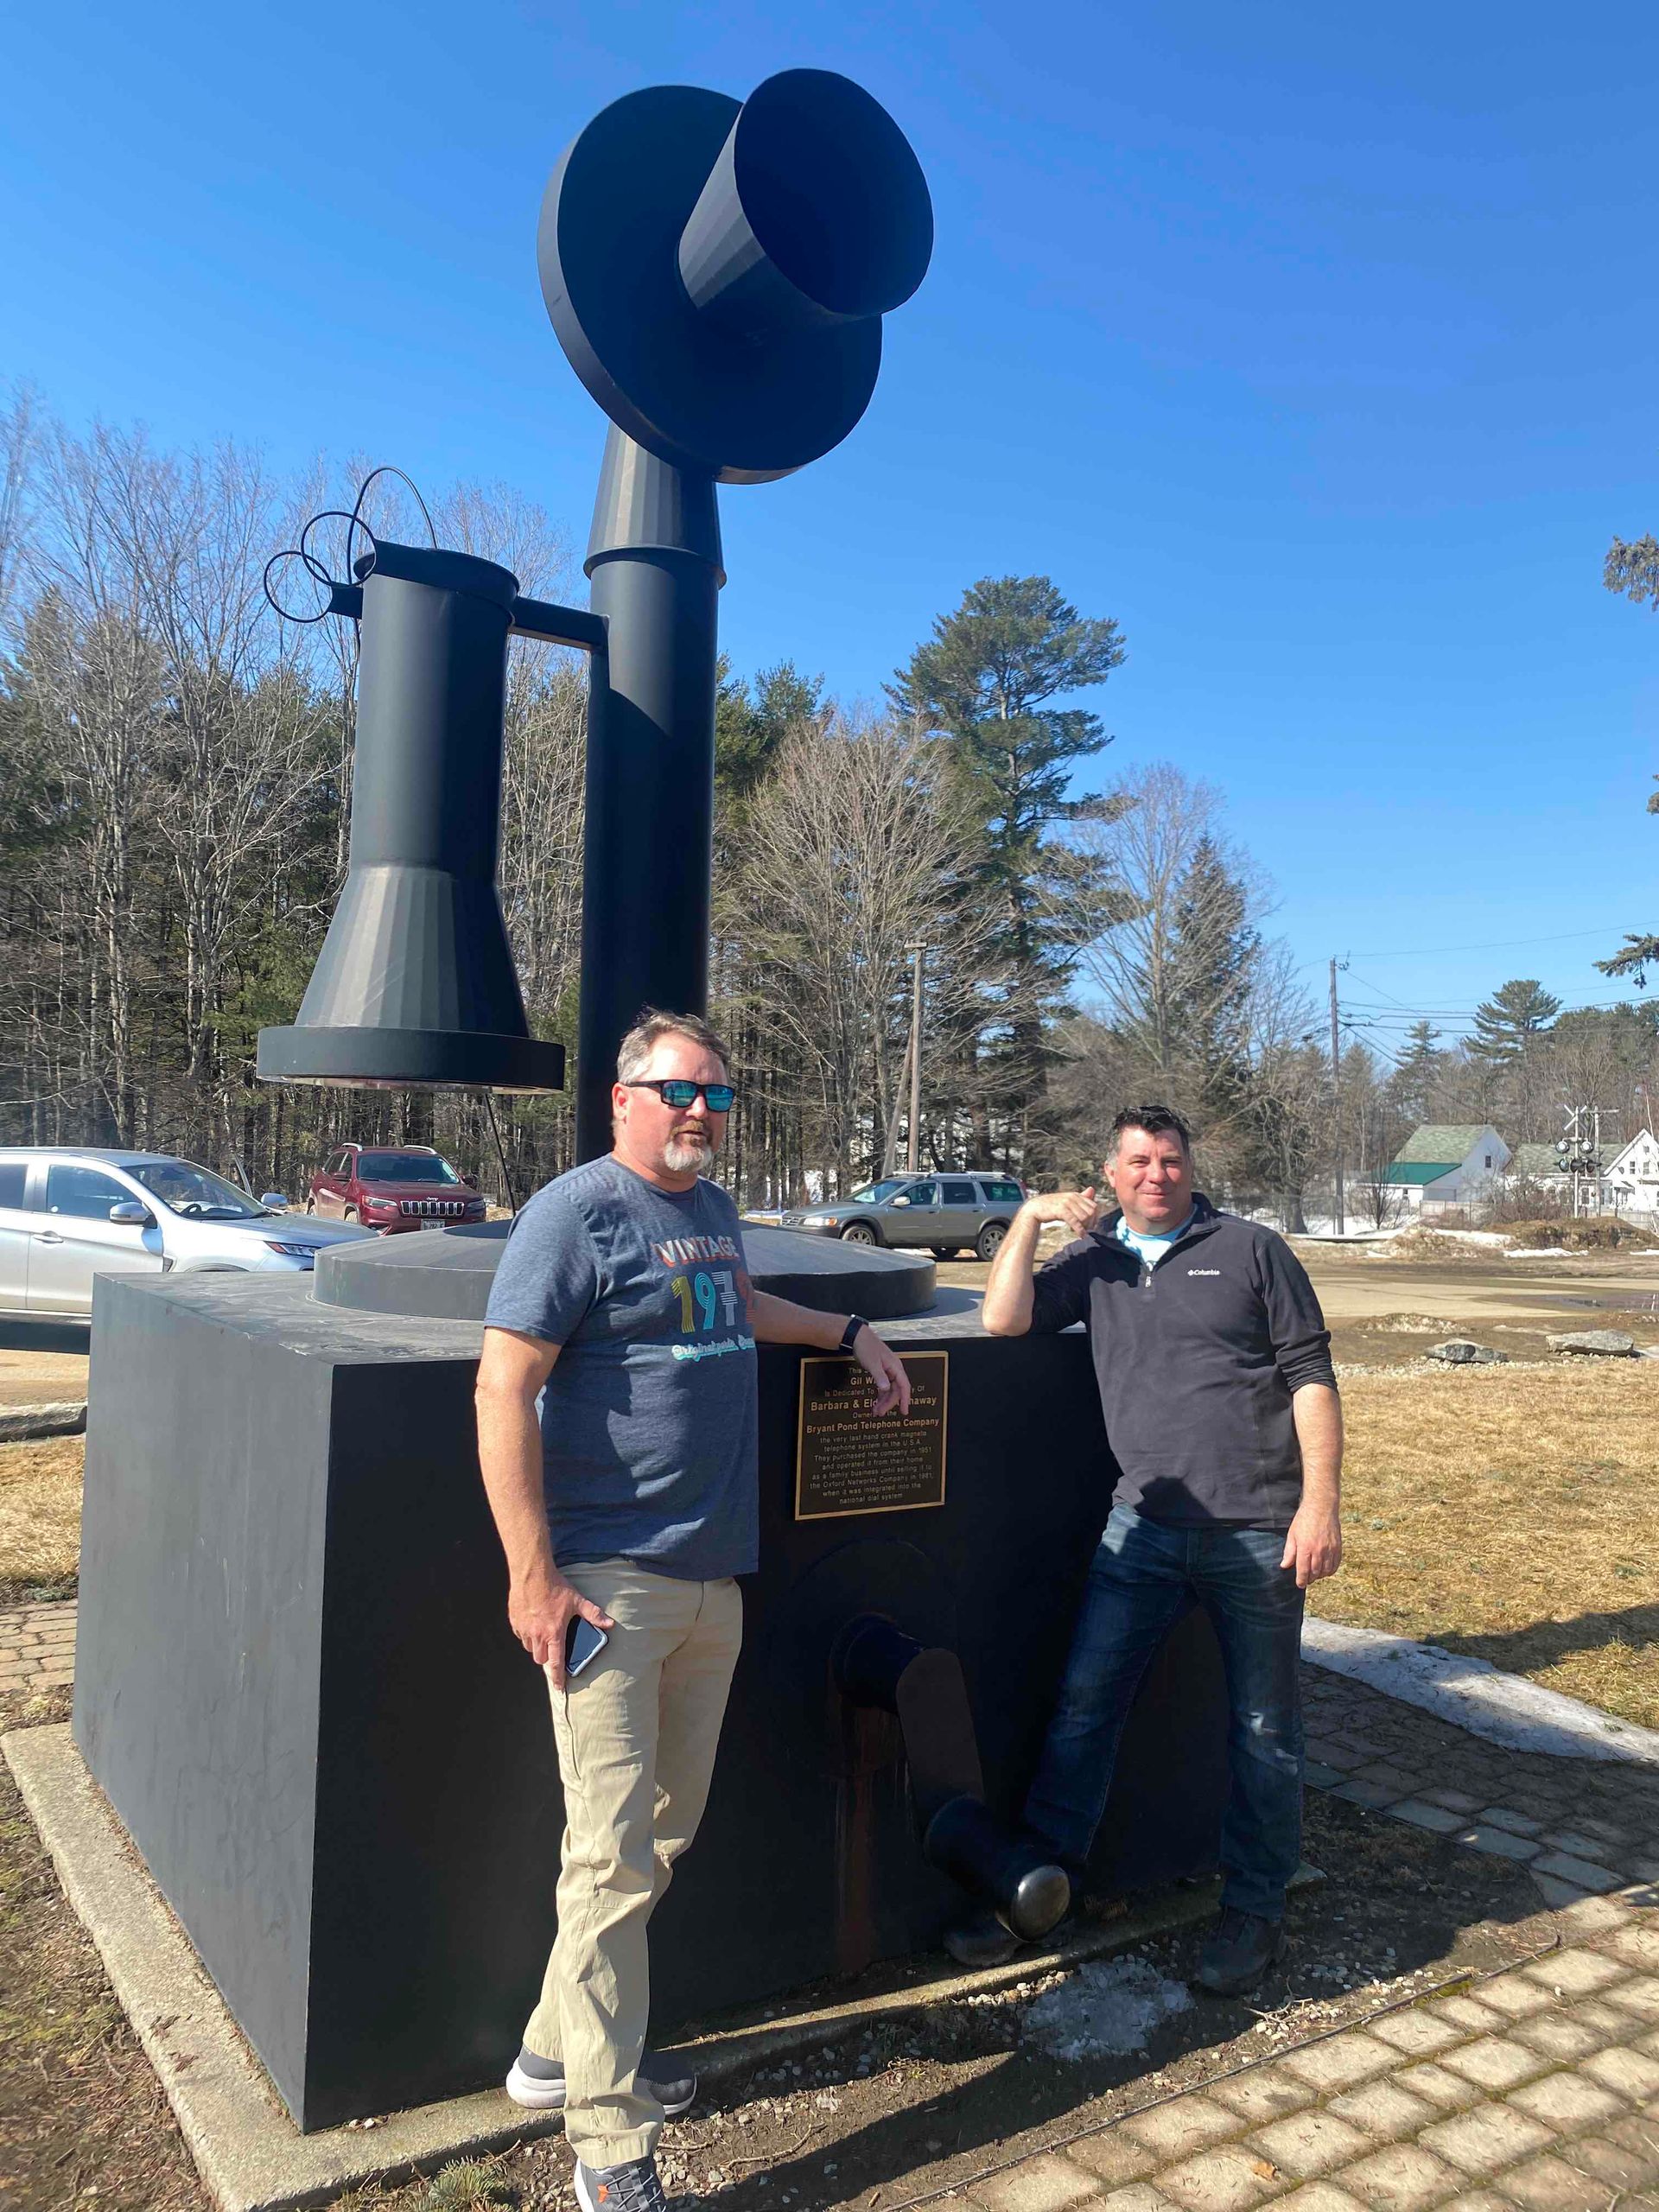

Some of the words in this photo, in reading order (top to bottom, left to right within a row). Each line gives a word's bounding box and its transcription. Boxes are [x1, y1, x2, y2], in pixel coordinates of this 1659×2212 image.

[653, 1235, 740, 1267] VINTAGE
[810, 1401, 849, 1411] Barbara
[853, 1399, 860, 1408] &
[806, 1425, 836, 1434] Bryant
[837, 1422, 858, 1431] Pond
[861, 1421, 901, 1431] Telephone
[904, 1418, 940, 1427] Company
[823, 1444, 856, 1452] telephone
[858, 1442, 880, 1451] system
[814, 1453, 830, 1462] They
[832, 1452, 865, 1461] purchased
[880, 1448, 908, 1457] company
[822, 1462, 835, 1471] and
[836, 1459, 865, 1469] operated
[823, 1479, 845, 1488] Oxford
[847, 1477, 877, 1486] Networks
[879, 1474, 908, 1483] Company
[829, 1471, 849, 1479] family
[863, 1484, 896, 1494] integrated
[839, 1495, 866, 1504] national
[868, 1493, 880, 1502] dial
[881, 1492, 904, 1502] system
